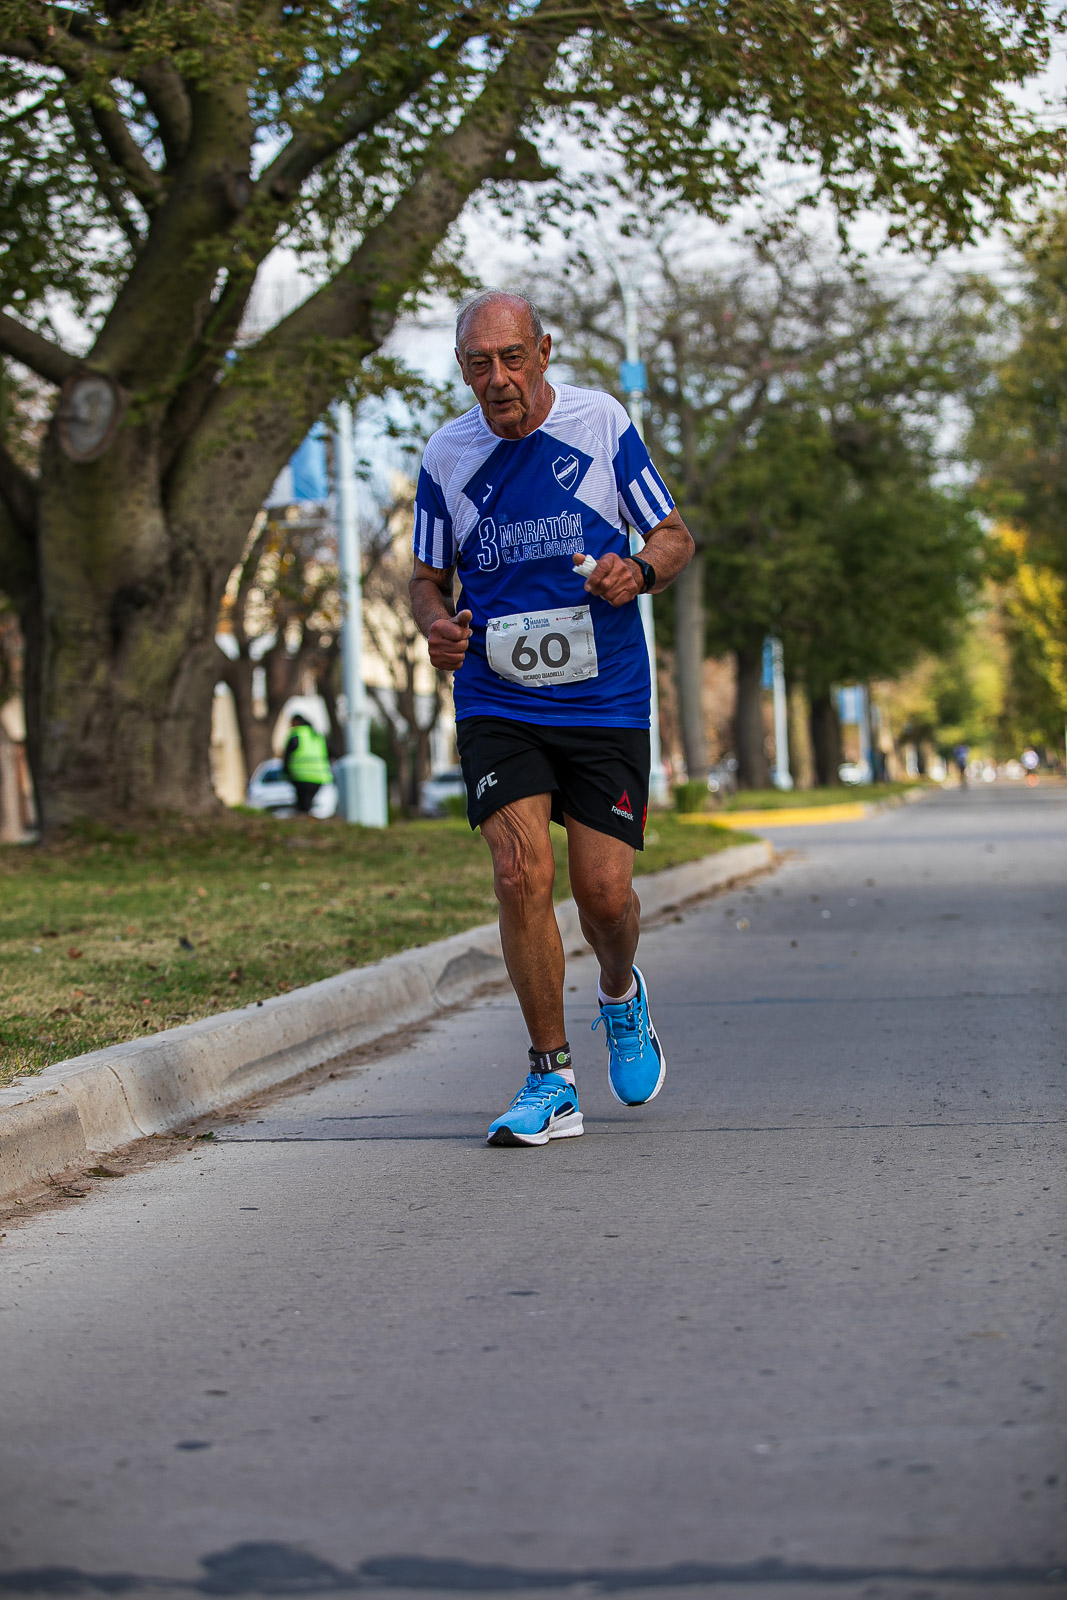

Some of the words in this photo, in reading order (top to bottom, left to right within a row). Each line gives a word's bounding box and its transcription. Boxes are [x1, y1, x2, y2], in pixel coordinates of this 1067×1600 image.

[477, 517, 500, 572] 3
[499, 510, 583, 548] MARATÓN
[523, 617, 530, 631] 3
[511, 632, 571, 672] 60
[522, 673, 542, 681] RICARDO
[476, 771, 498, 800] UFC
[611, 805, 634, 821] Reebok
